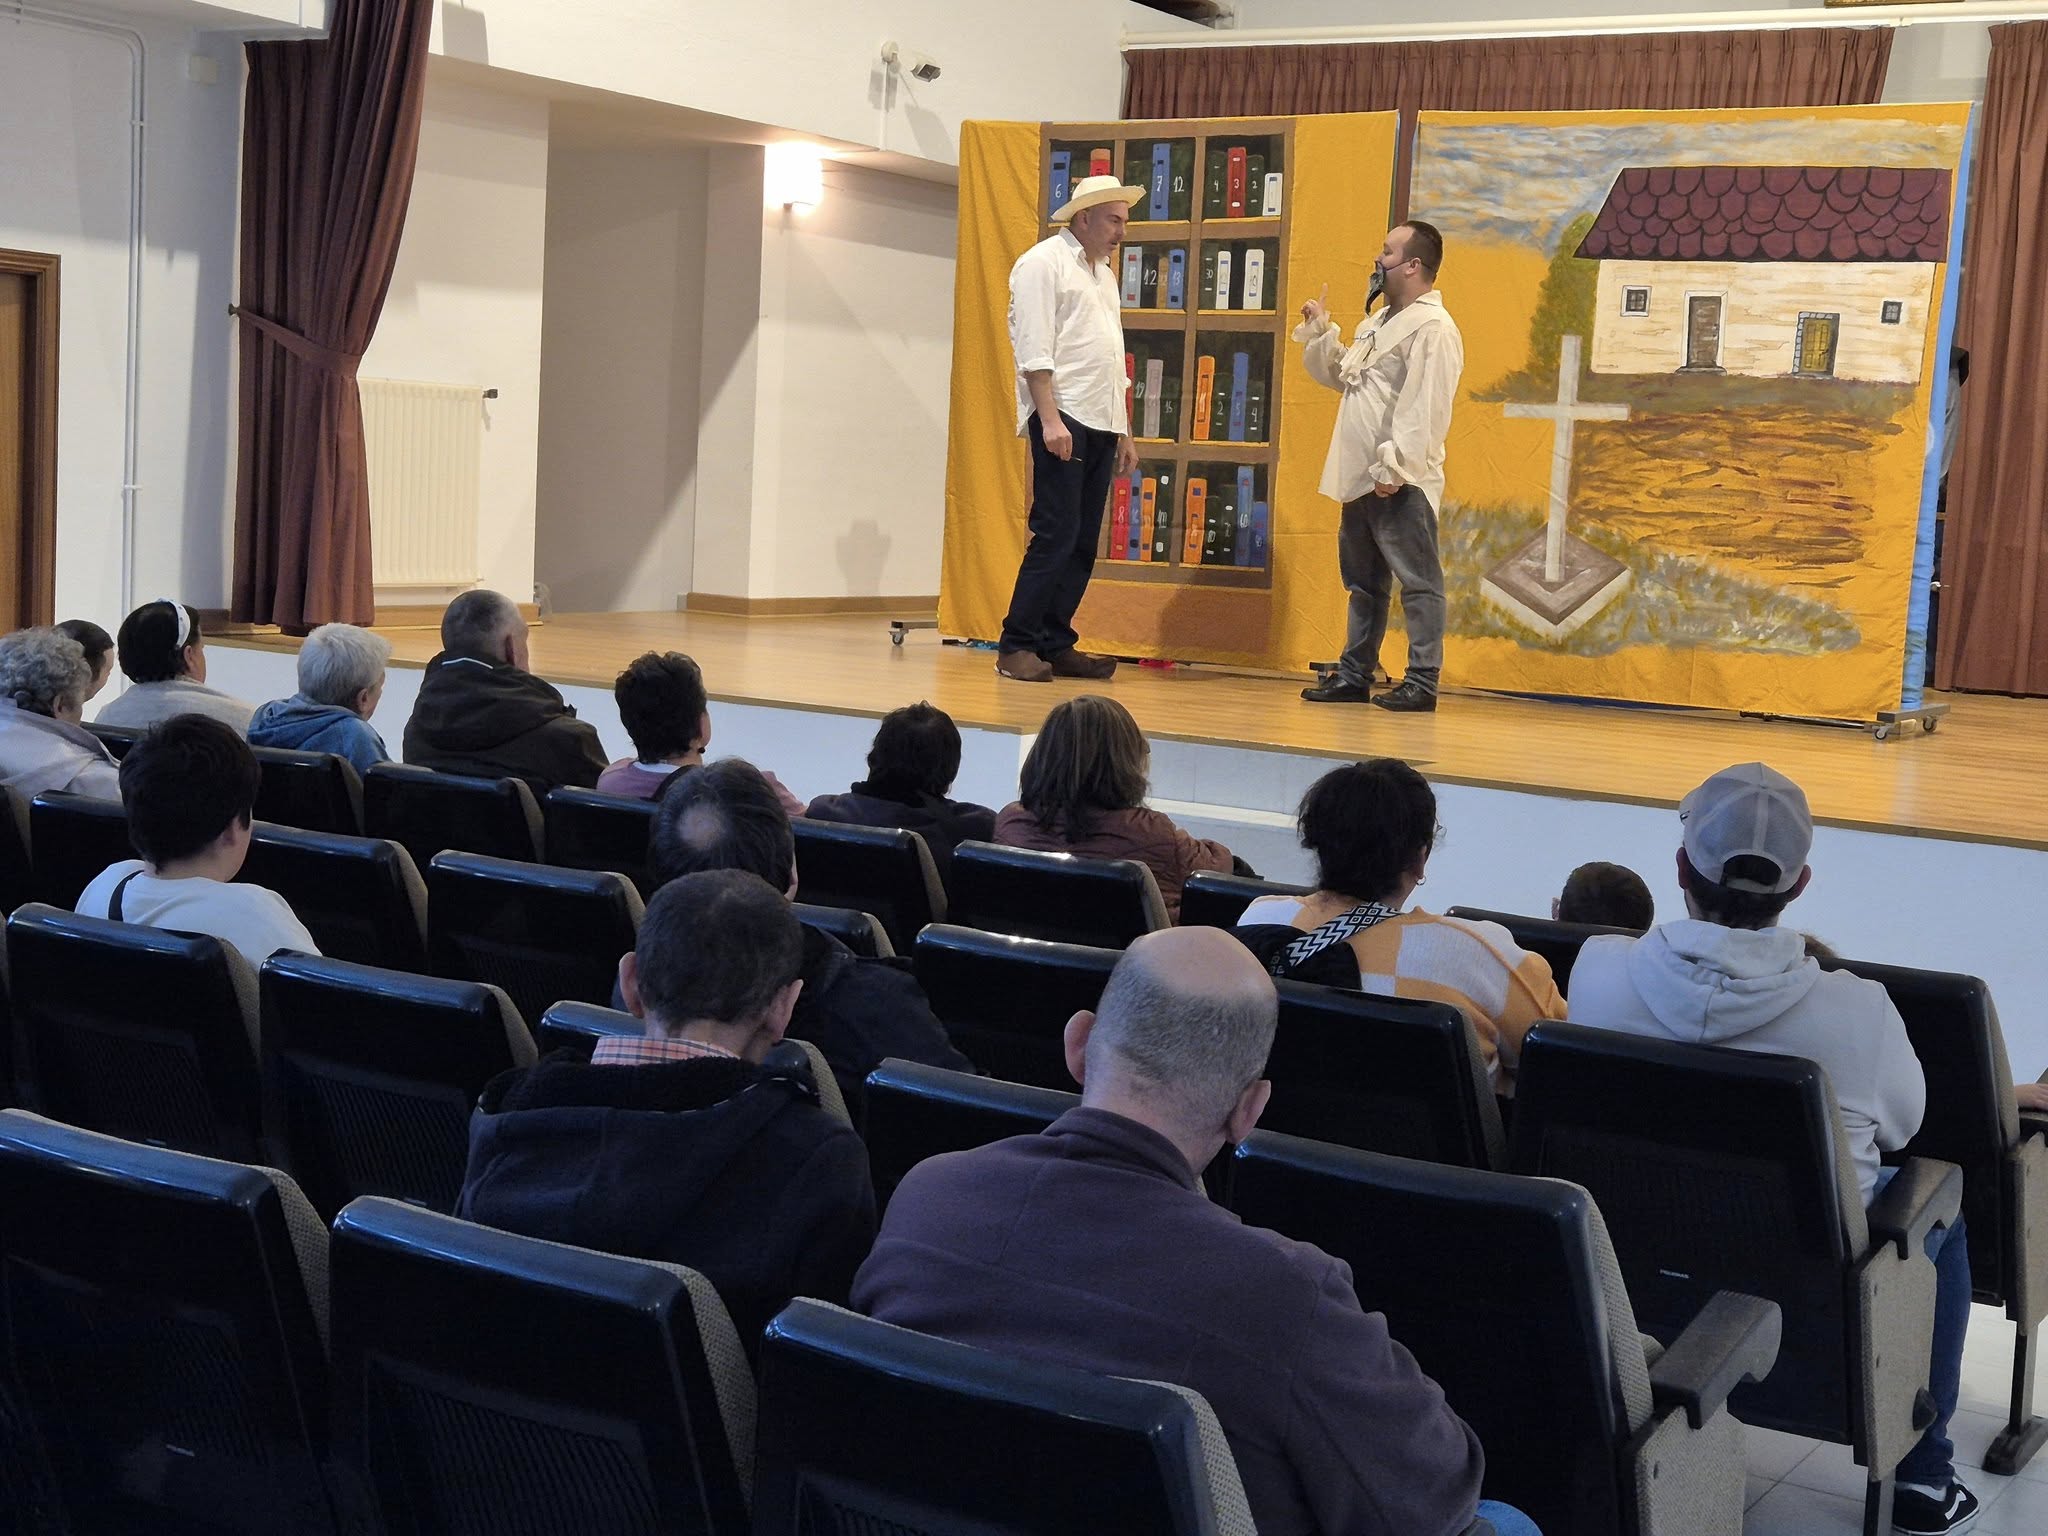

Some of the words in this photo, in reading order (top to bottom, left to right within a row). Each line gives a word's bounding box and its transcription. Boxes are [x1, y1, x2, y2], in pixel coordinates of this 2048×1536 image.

[1055, 184, 1062, 198] 6
[1156, 176, 1162, 192] 7
[1174, 176, 1184, 192] 12
[1234, 178, 1240, 188] 3
[1252, 180, 1258, 188] 2
[1144, 269, 1156, 285] 12
[1173, 270, 1182, 287] 13
[1217, 401, 1224, 415] 2
[1118, 506, 1124, 523] 8
